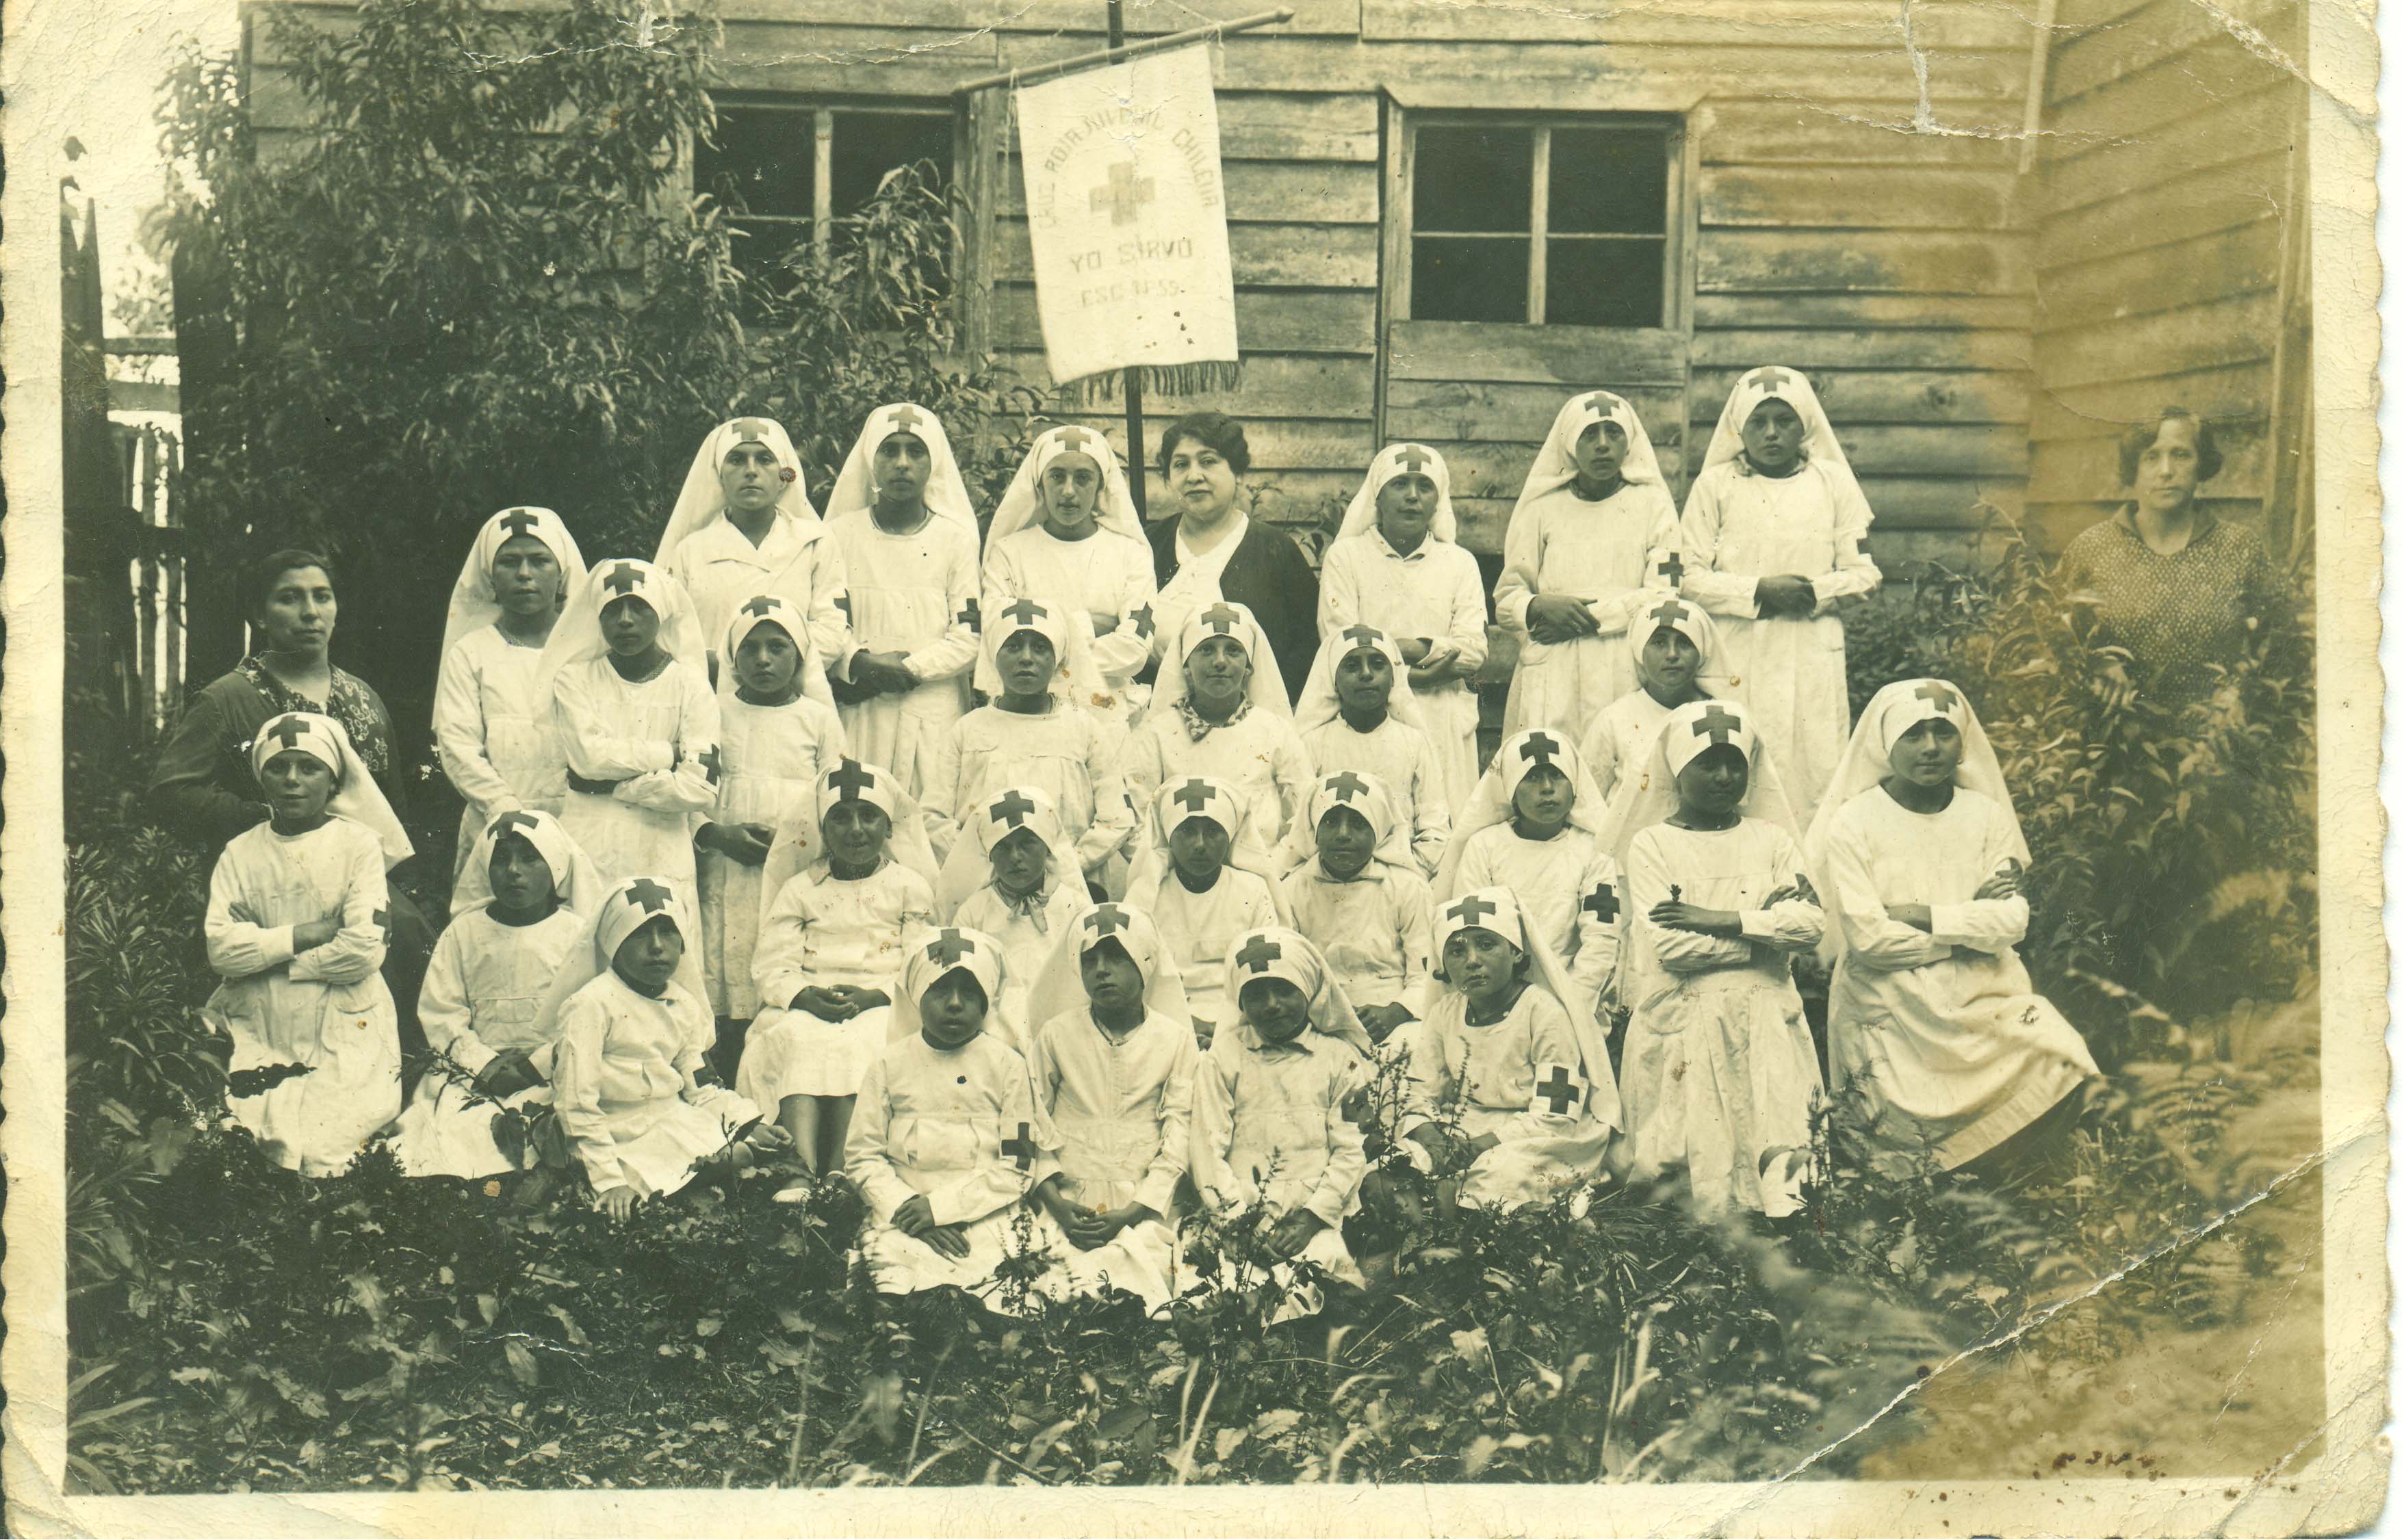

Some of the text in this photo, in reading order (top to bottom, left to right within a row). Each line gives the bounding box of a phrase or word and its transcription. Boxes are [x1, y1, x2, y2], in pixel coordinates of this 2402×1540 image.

[1045, 128, 1083, 172] ROJA
[1172, 128, 1218, 208] CHILENA
[1070, 239, 1193, 274] YO SIRVO
